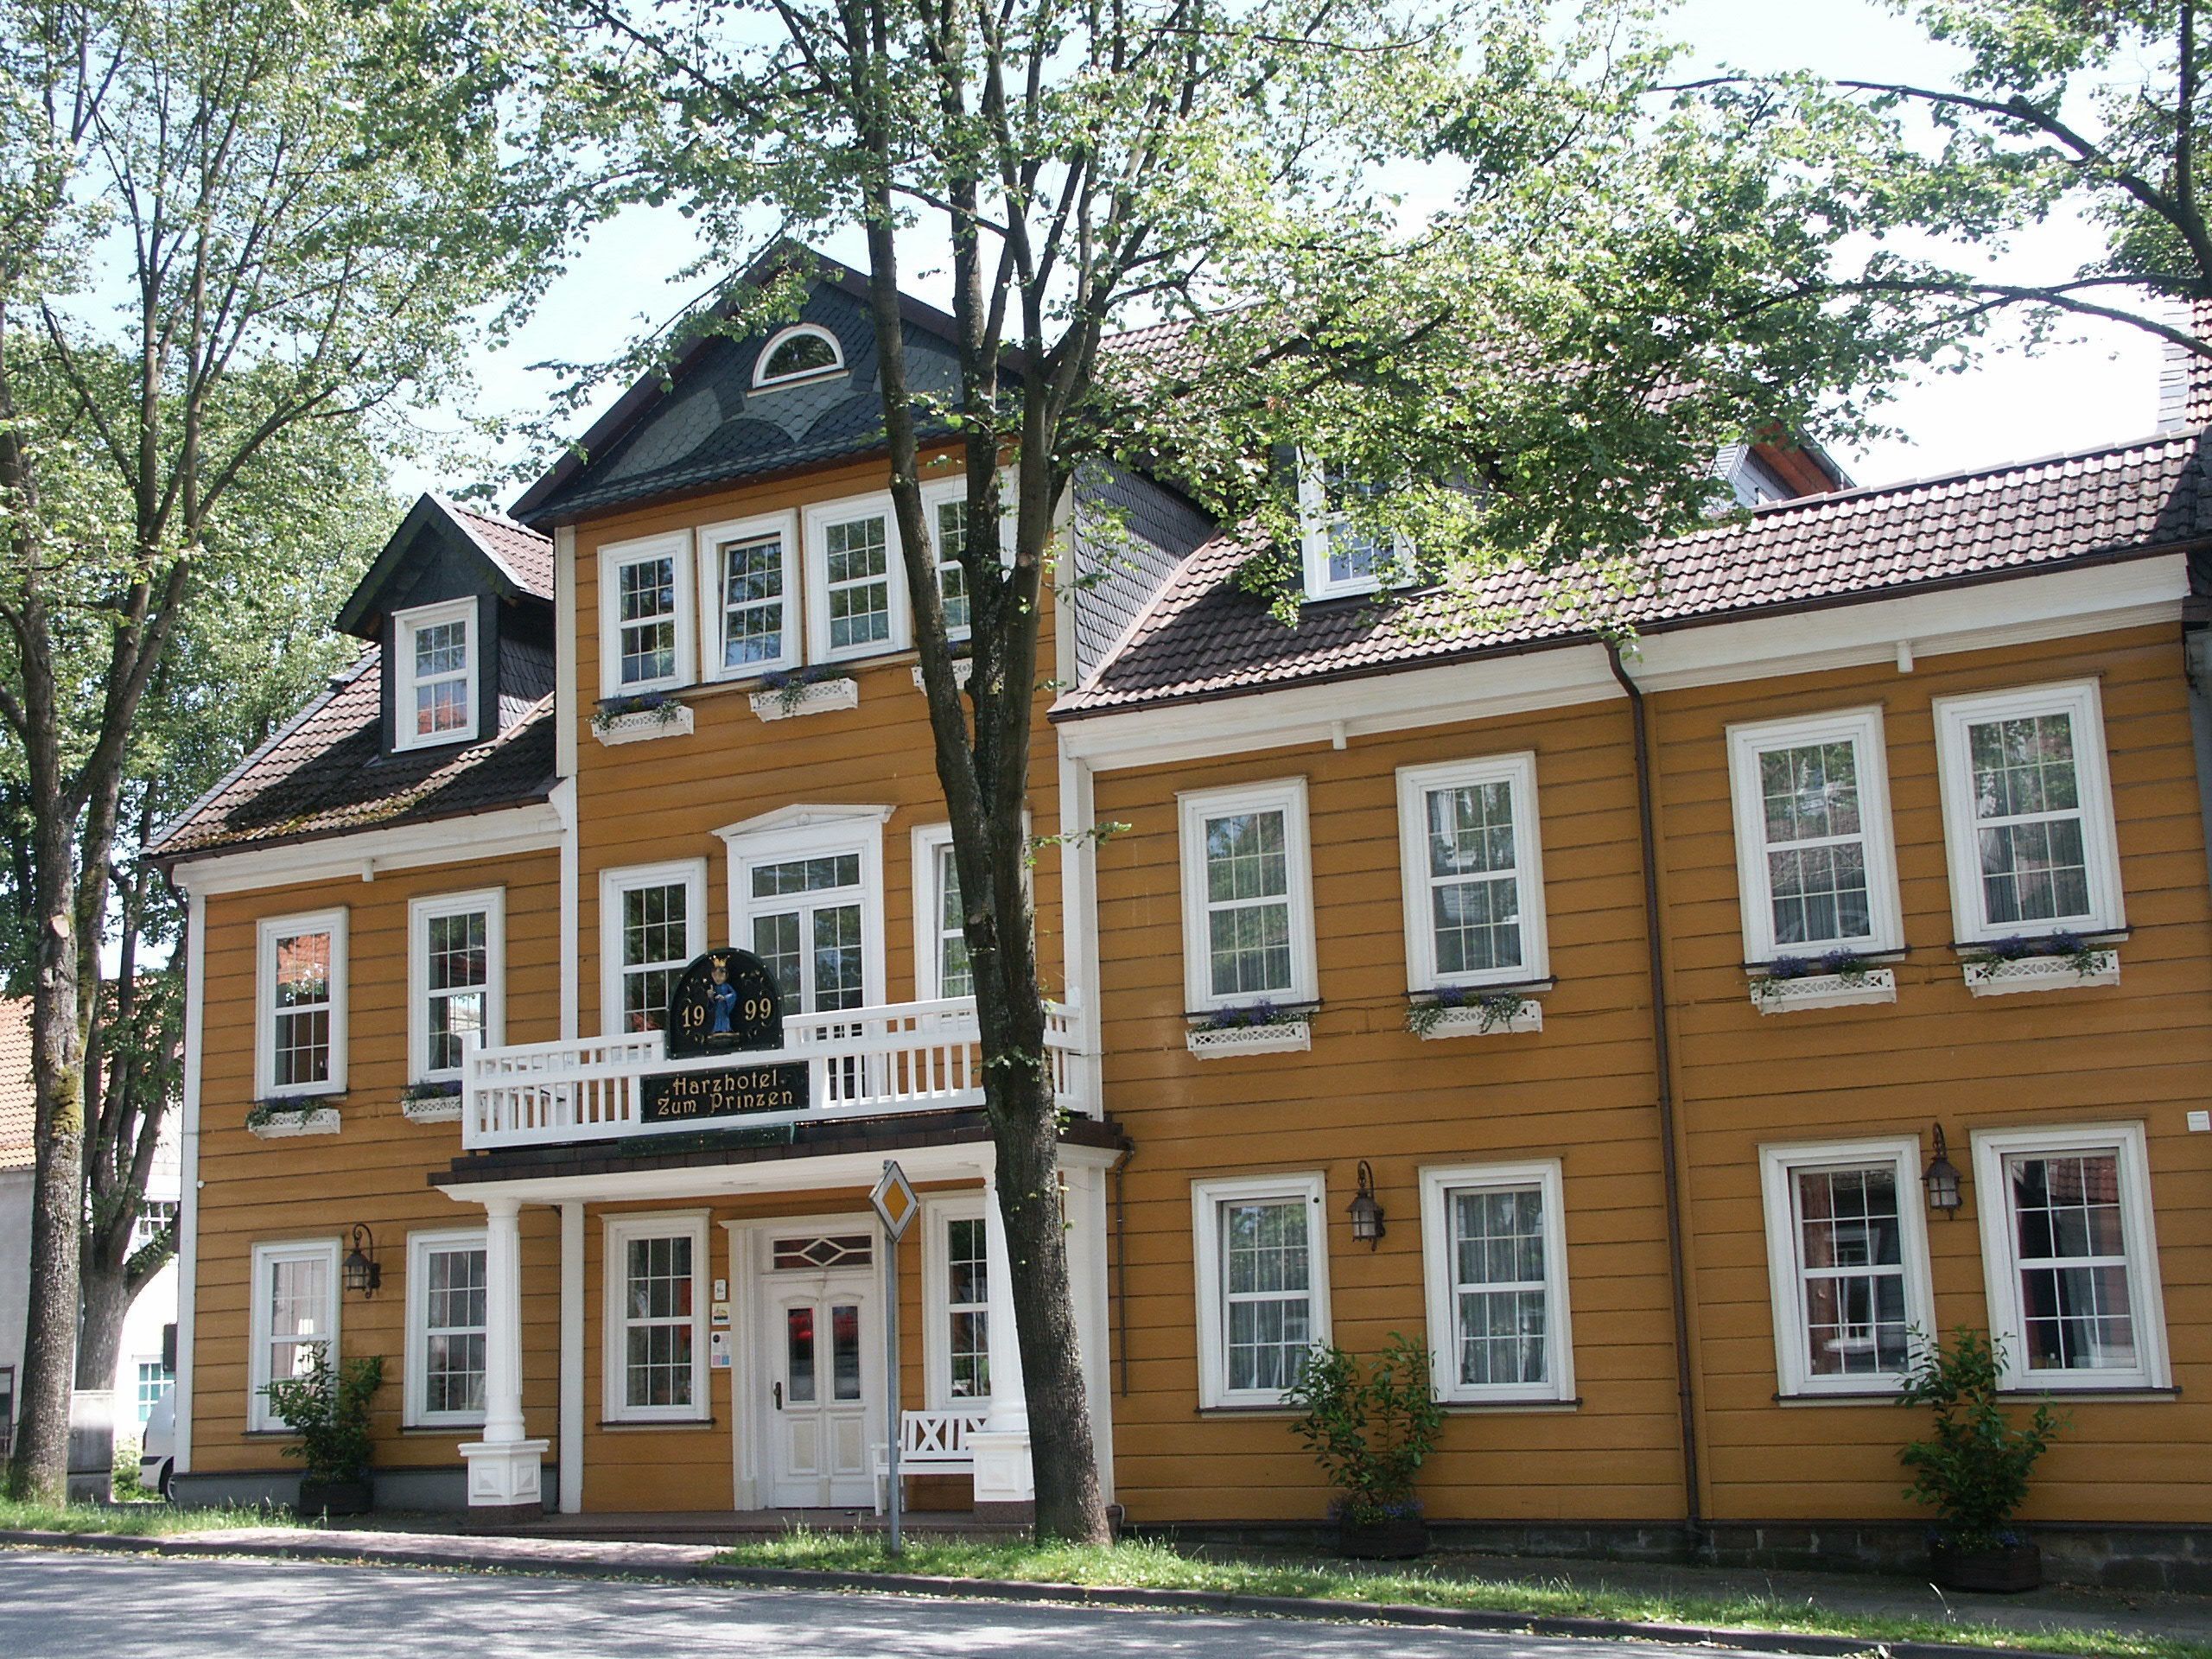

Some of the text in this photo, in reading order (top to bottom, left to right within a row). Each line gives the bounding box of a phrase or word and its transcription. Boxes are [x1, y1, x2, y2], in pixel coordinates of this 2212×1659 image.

[681, 997, 772, 1027] 19 99
[672, 1069, 778, 1096] Harzhotel
[709, 1090, 793, 1114] Prinzen
